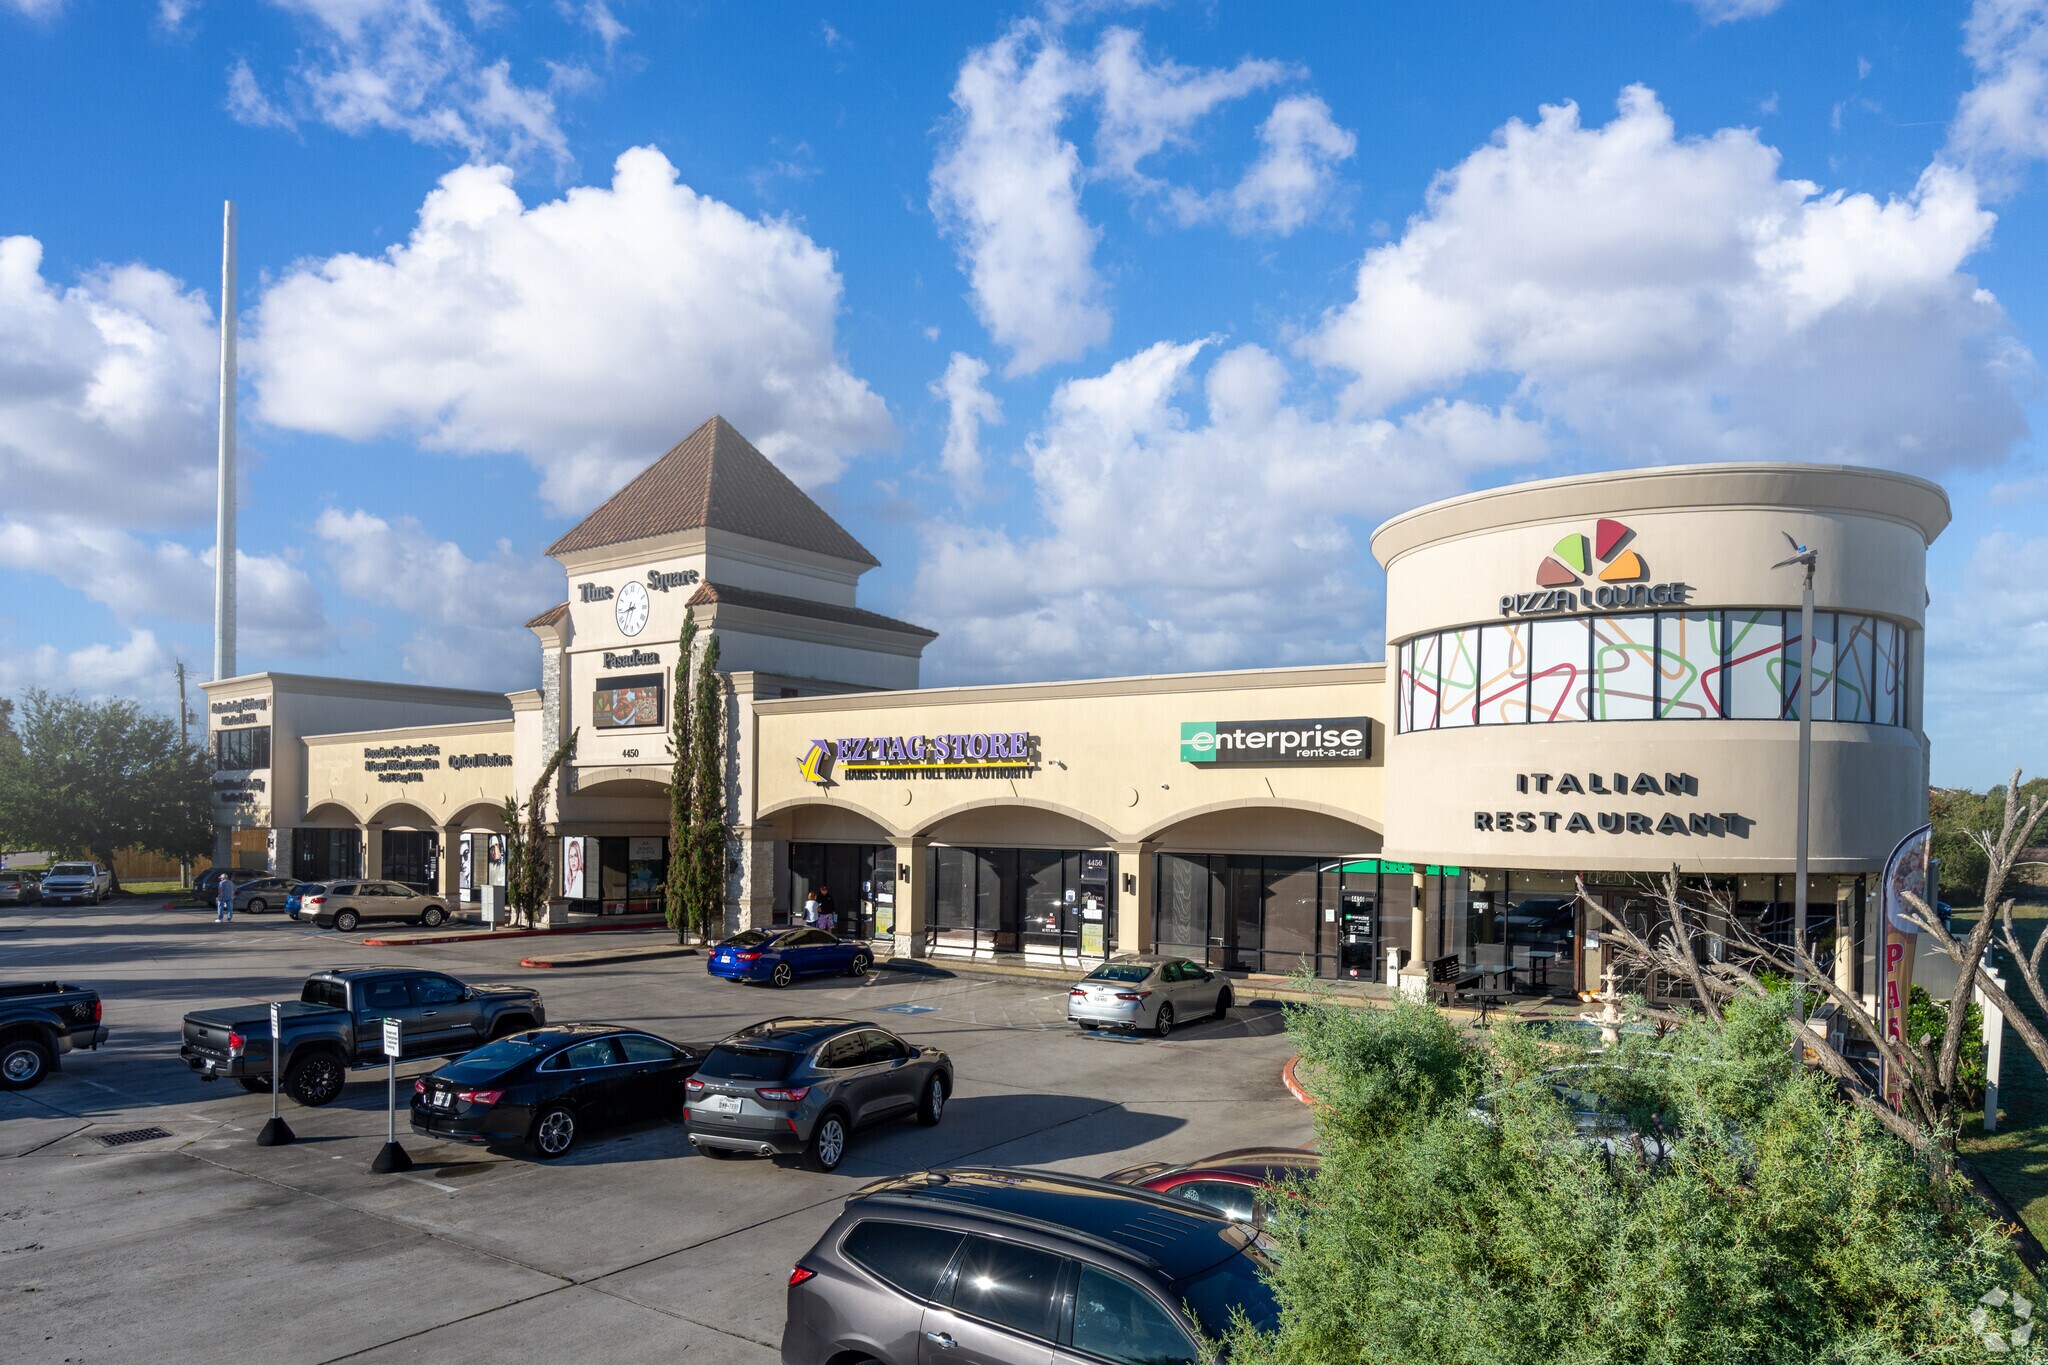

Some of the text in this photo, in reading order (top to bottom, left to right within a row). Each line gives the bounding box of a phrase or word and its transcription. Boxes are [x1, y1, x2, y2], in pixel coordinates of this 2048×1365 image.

[647, 569, 699, 593] Square
[578, 582, 614, 603] Time
[1499, 582, 1686, 615] PIZZA LOUNGE
[603, 649, 660, 669] Pasadena
[837, 732, 1029, 761] EZ TAG STORE
[1189, 724, 1363, 754] enterprise
[448, 755, 477, 771] Optical
[622, 749, 639, 758] 4450
[1296, 748, 1363, 758] rent-a-car
[845, 766, 1035, 780] HARRIS COUNTY TOLL ROAD AUTHORITY
[1516, 772, 1688, 793] ITALIAN
[1474, 811, 1741, 833] RESTAURANT
[1087, 859, 1103, 867] 4450
